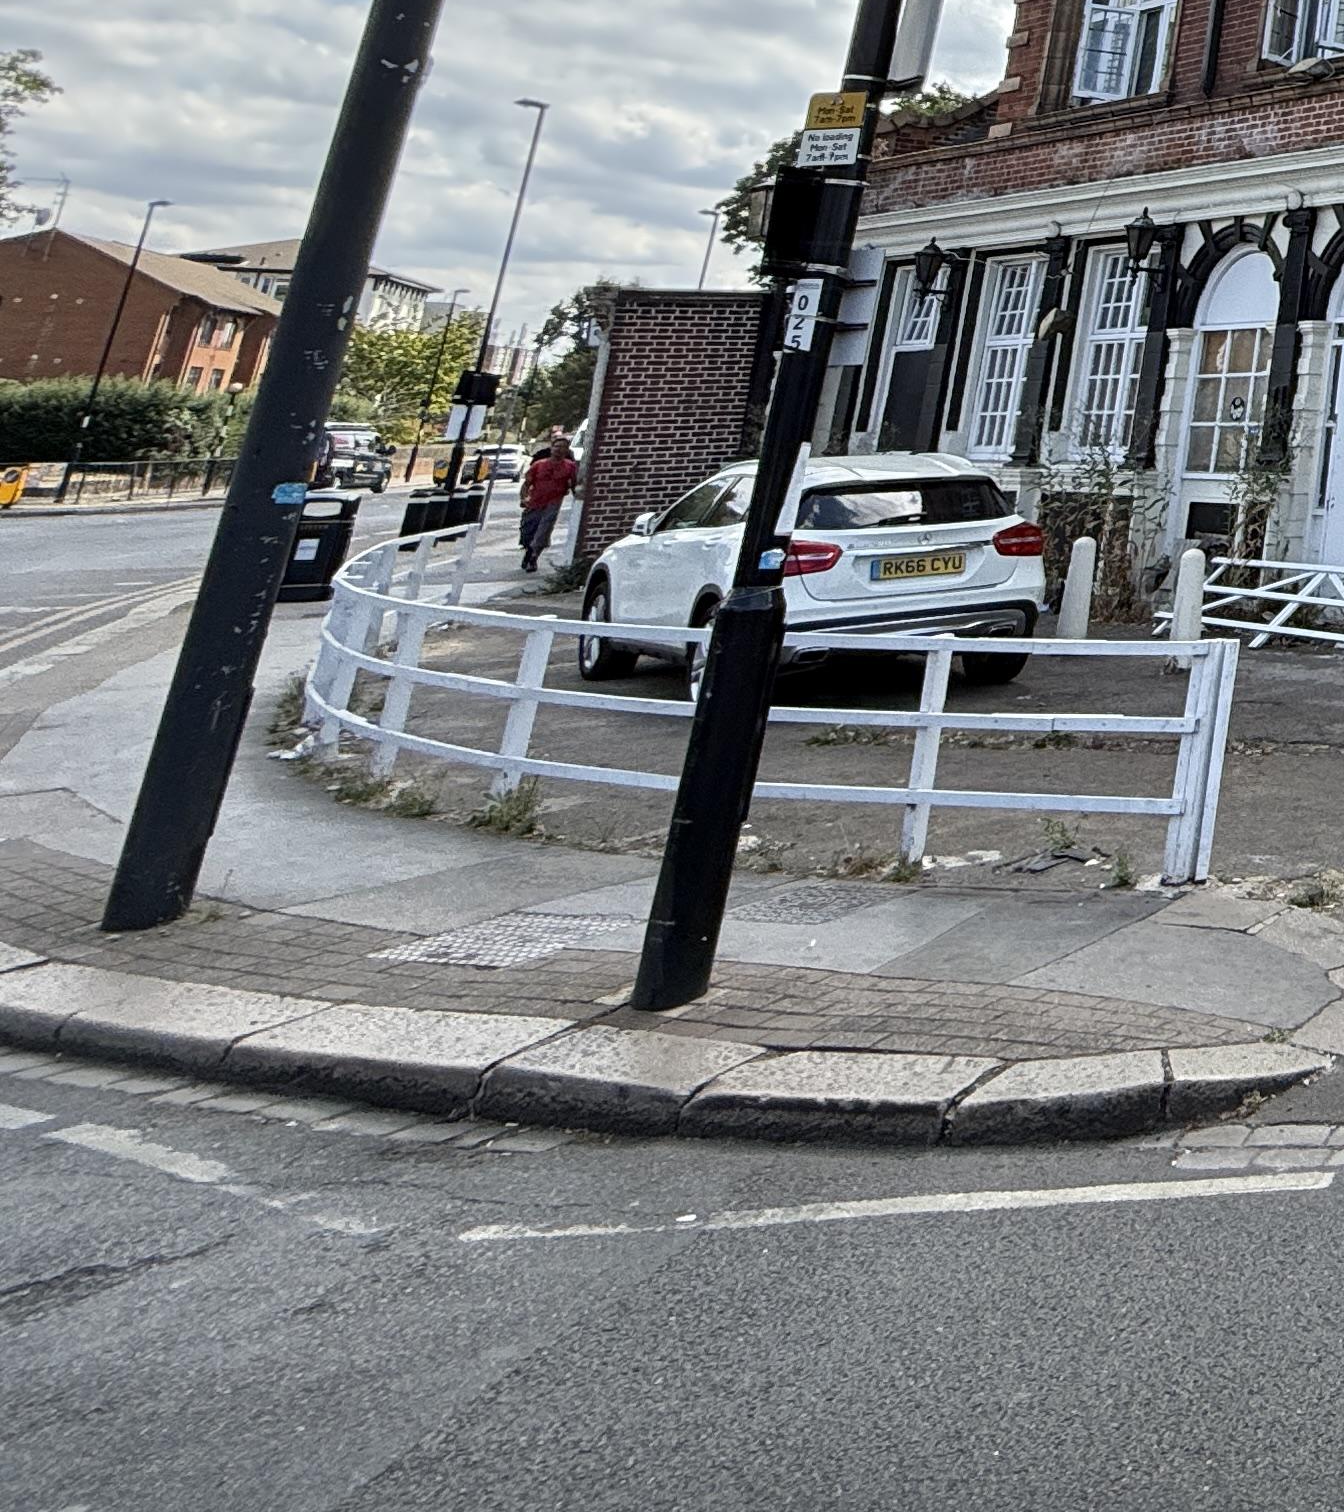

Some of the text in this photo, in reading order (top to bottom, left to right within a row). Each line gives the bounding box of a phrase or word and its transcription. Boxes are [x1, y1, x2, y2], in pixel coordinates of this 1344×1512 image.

[822, 132, 853, 142] loading
[883, 555, 963, 576] RK66 CYU
